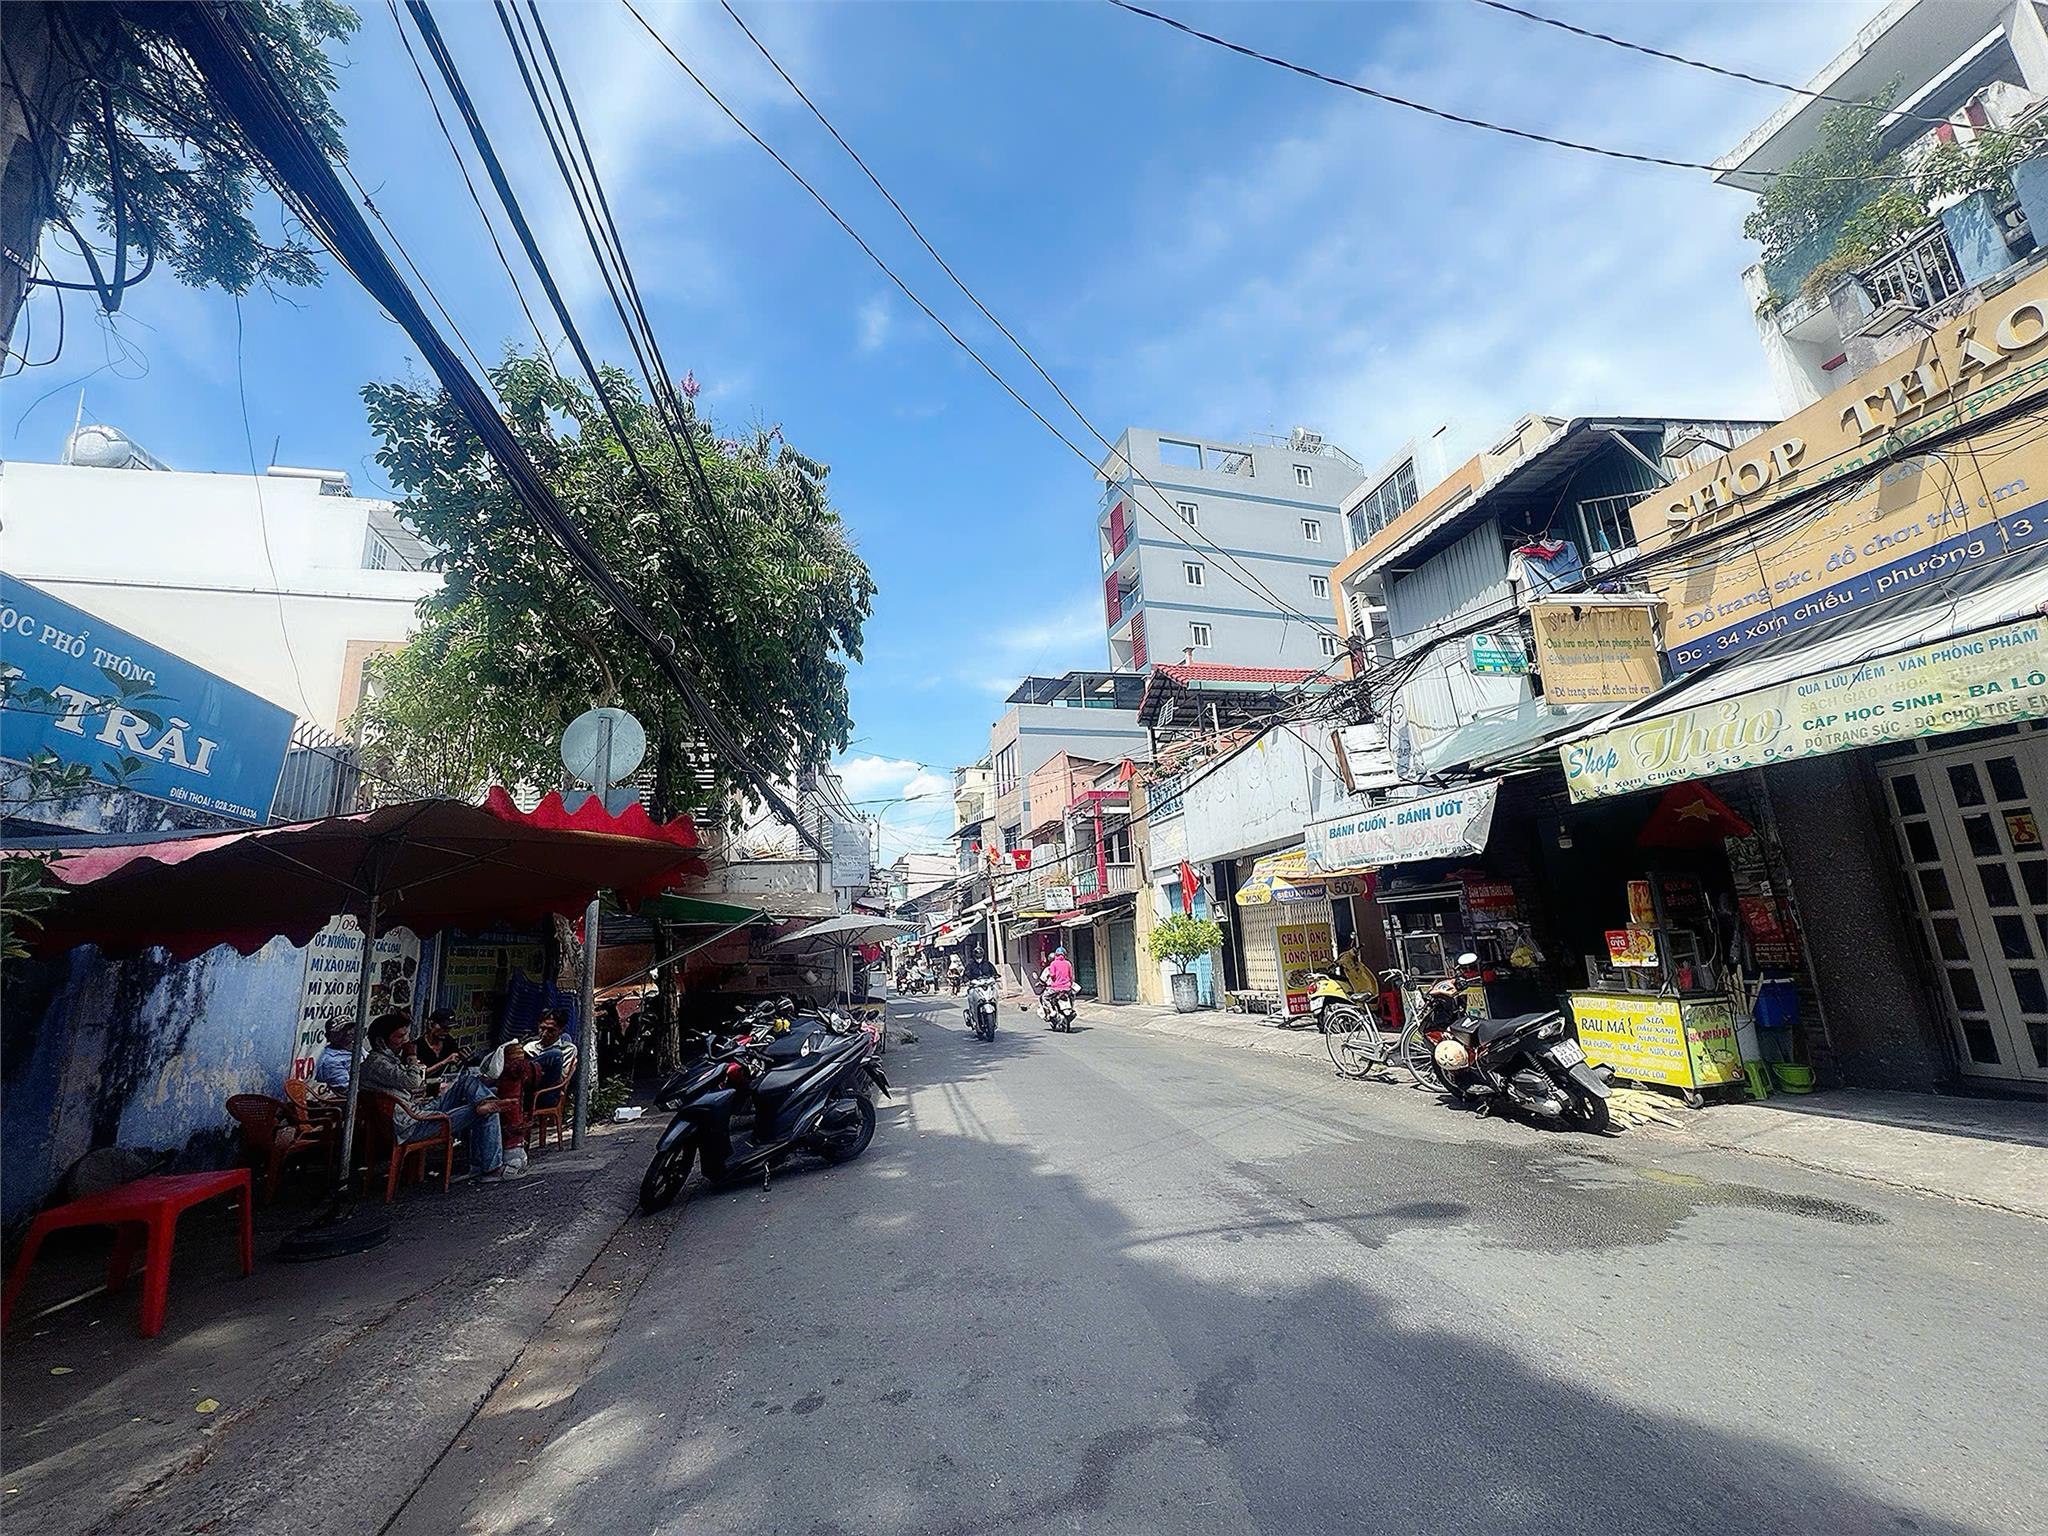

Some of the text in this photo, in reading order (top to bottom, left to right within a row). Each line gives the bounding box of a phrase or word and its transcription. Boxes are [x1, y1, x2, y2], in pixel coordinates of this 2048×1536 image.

[1664, 438, 1806, 531] SHOP
[1676, 646, 1703, 665] Đc
[1716, 633, 1741, 650] 34
[1745, 615, 1789, 640] xóm
[1794, 590, 1853, 621] chiếu
[1876, 539, 1986, 593] phường
[1996, 519, 2034, 547] 13
[1717, 587, 1771, 618] trang
[1826, 543, 1858, 572] đồ
[0, 604, 157, 687] ỌC PHỔ THÔNG
[1931, 641, 1984, 665] PHÒNG
[1987, 626, 2039, 651] PHẨM
[1844, 705, 1885, 722] HỌC
[1892, 693, 1943, 712] SINH
[1968, 682, 2003, 698] BA
[2011, 670, 2046, 690] LÔ
[50, 683, 220, 776] TRÃI
[1569, 700, 1791, 779] Shop Thảo
[1826, 727, 1868, 745] TRANG
[1329, 822, 1355, 839] BÁNH
[1358, 814, 1386, 834] CUỐN
[1397, 808, 1431, 825] BÁNH
[1435, 800, 1463, 819] ƯỚT
[1334, 880, 1359, 894] 50%
[311, 954, 324, 972] MÌ
[324, 955, 345, 973] XÀO
[308, 978, 361, 996] MÌ XÀO BÒ
[303, 1002, 319, 1020] MÌ
[319, 1001, 341, 1019] XÀO
[1581, 1017, 1603, 1033] RAU
[1606, 1017, 1627, 1035] MÁ
